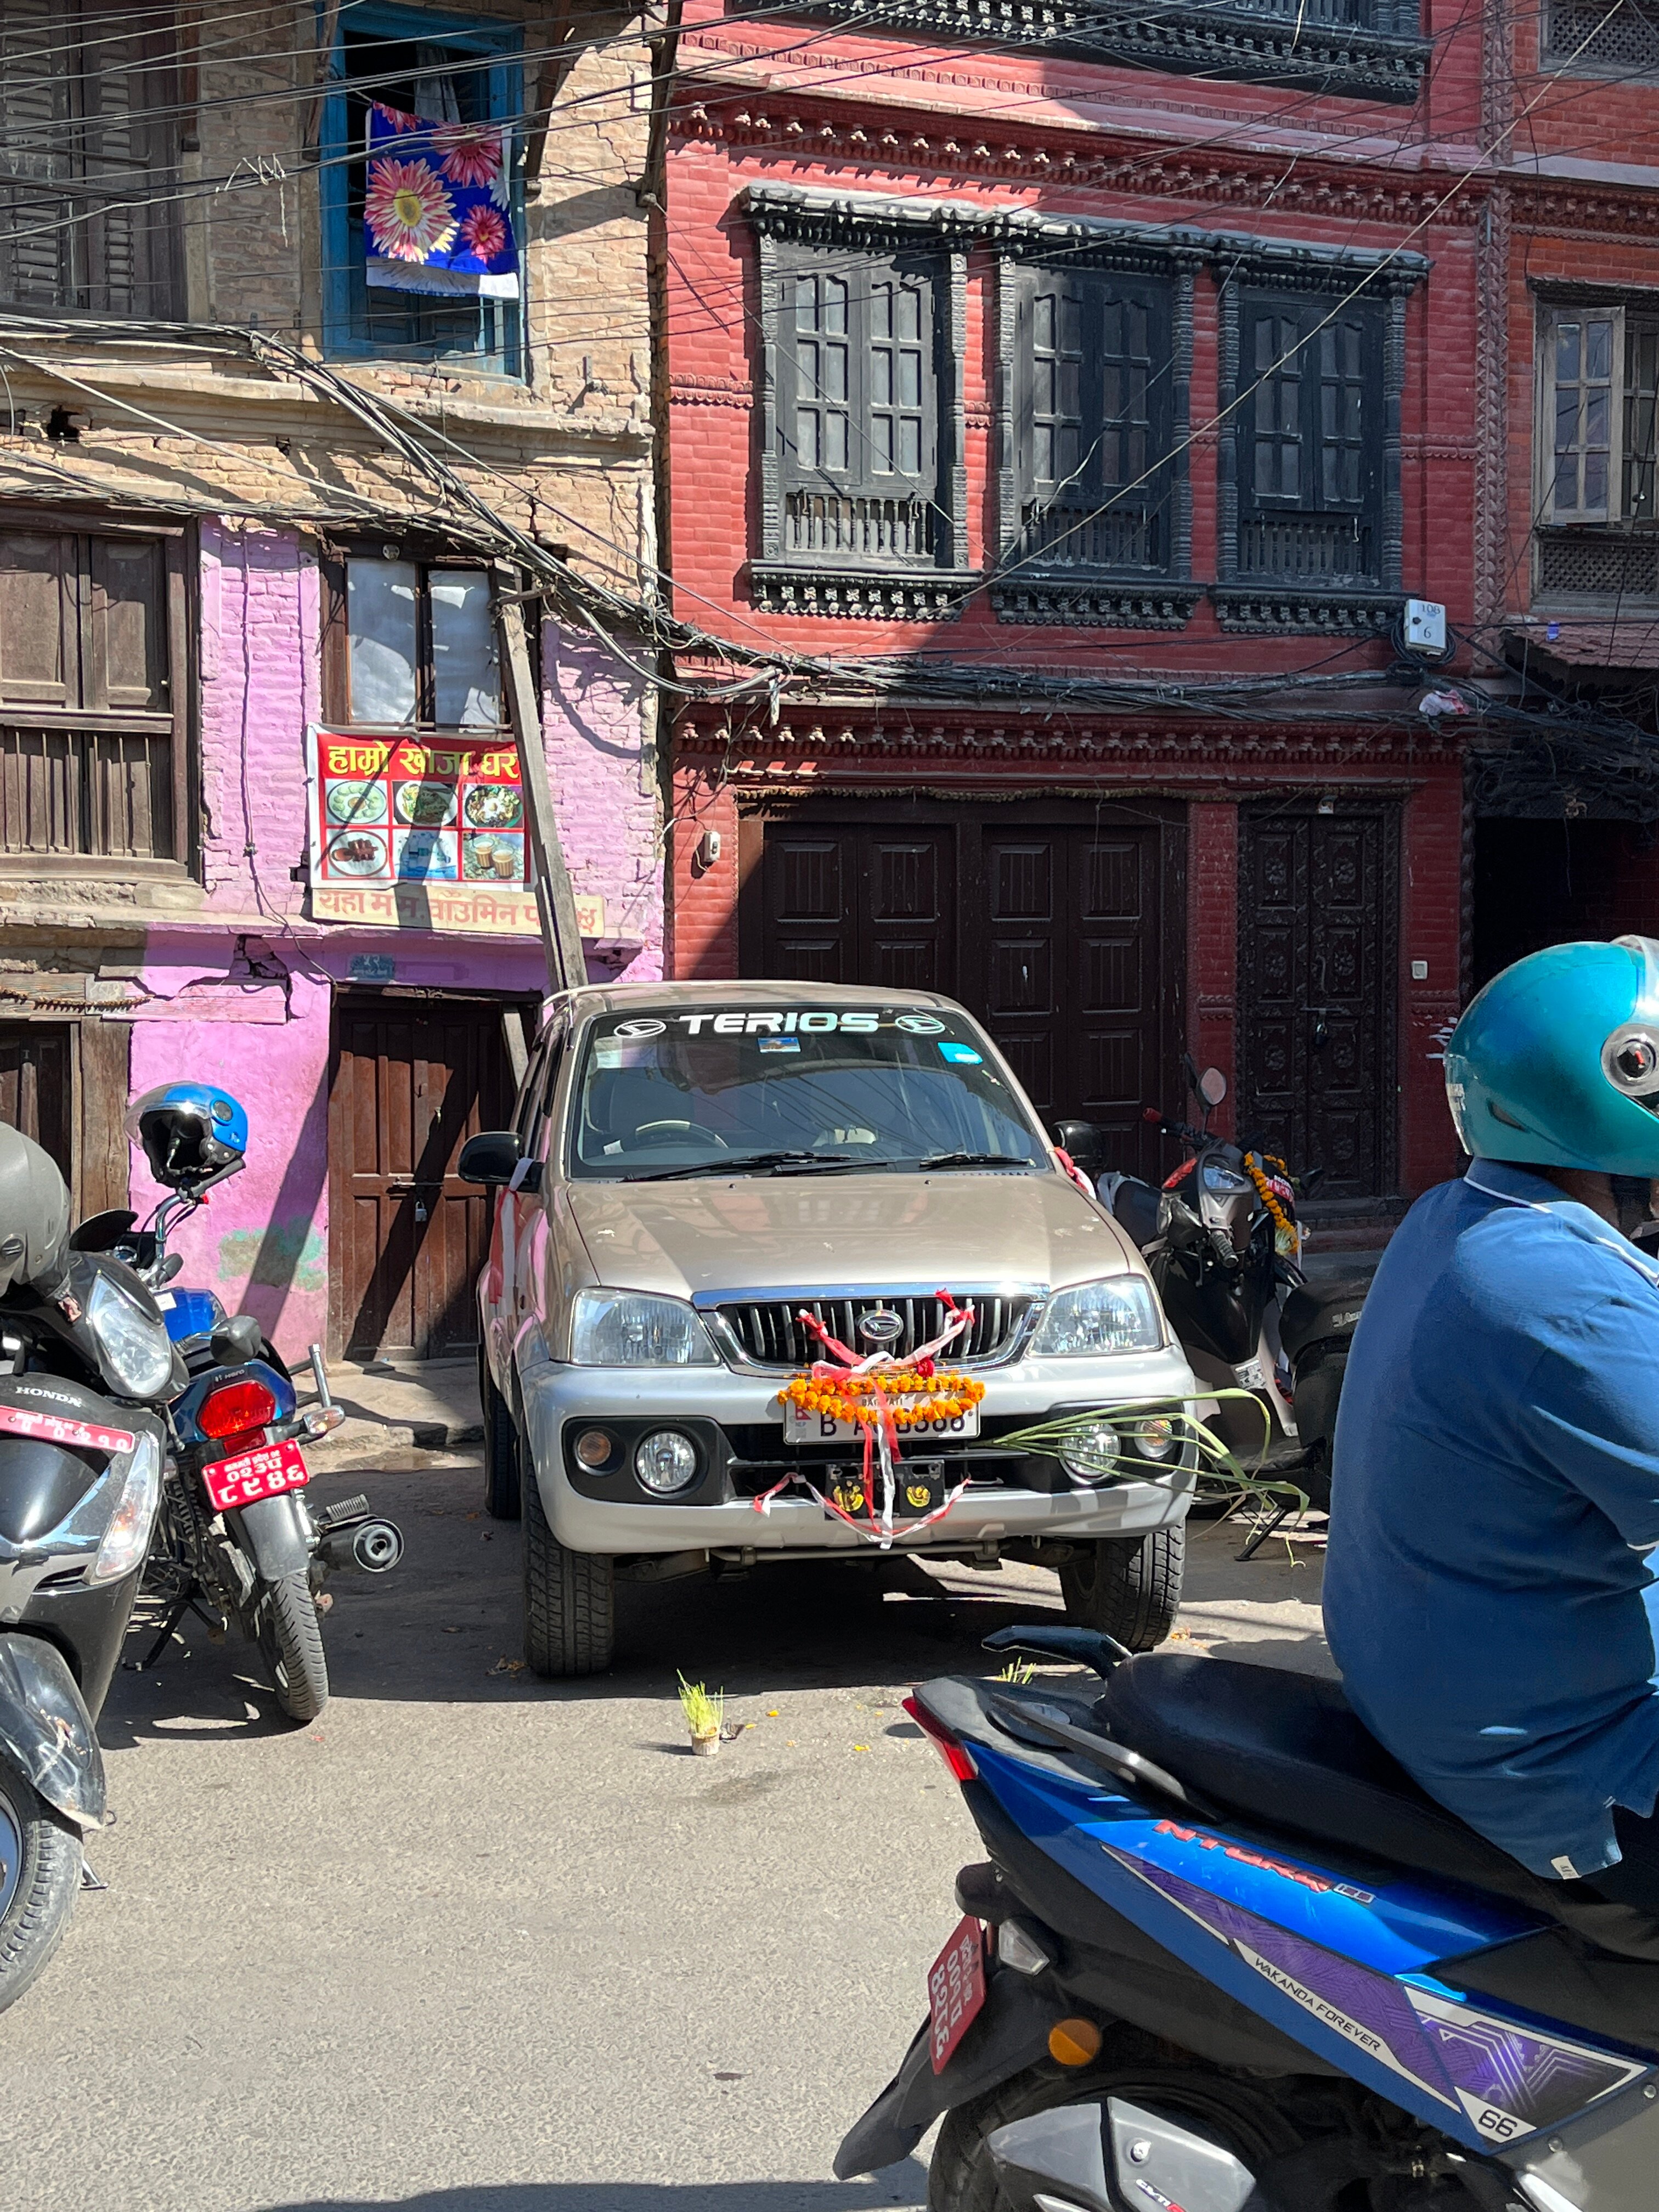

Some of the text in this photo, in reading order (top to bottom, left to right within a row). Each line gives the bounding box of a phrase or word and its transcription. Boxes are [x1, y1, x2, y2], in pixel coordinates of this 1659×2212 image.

[1421, 604, 1440, 614] 108
[1424, 626, 1431, 639] 6
[328, 741, 390, 776] हाम्रो
[480, 752, 519, 778] घर
[679, 1012, 879, 1034] TERIOS
[15, 1386, 83, 1408] HONDA
[1255, 1957, 1381, 2051] WAKANDA FOREVER
[1479, 2109, 1517, 2137] 66
